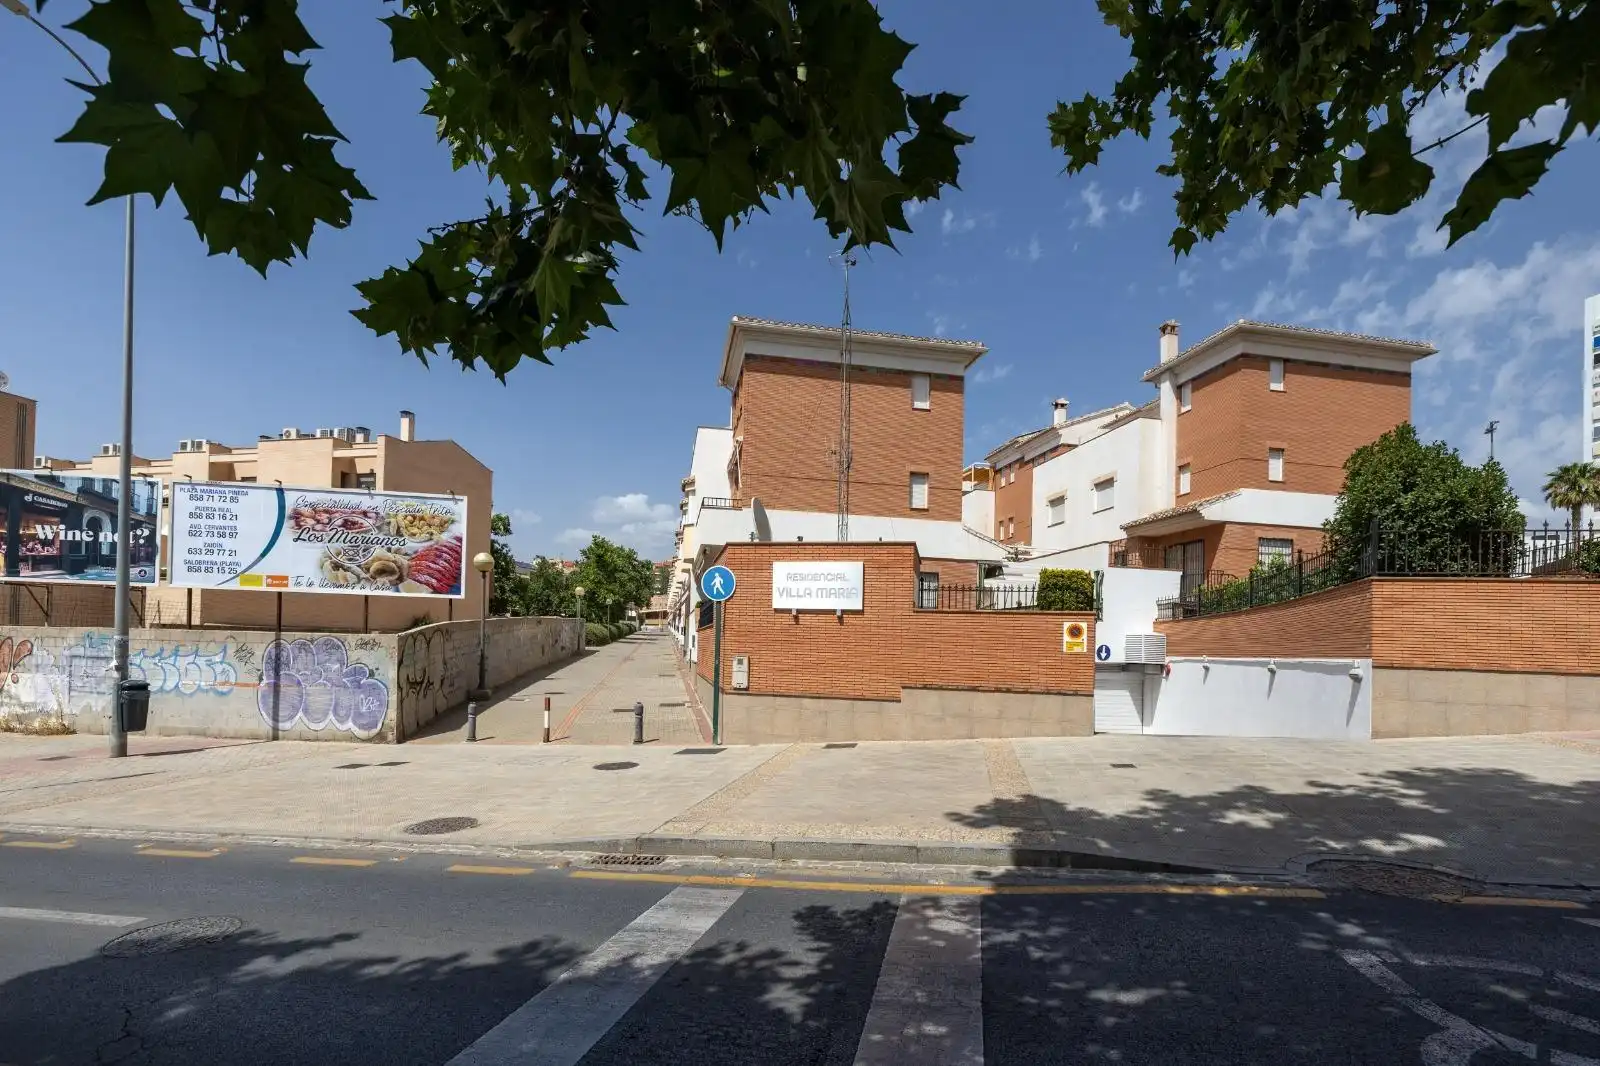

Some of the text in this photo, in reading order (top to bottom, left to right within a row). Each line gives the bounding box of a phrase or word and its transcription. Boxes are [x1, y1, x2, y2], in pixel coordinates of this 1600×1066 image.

[189, 494, 204, 502] 858
[218, 495, 228, 503] 72
[295, 495, 452, 516] Especialidad en Pescado Frito
[188, 512, 203, 520] 858
[205, 513, 215, 521] 83
[36, 524, 94, 542] Wine
[188, 530, 203, 538] 622
[216, 531, 227, 539] 58
[293, 526, 408, 547] Los Marianos
[187, 548, 203, 556] 633
[217, 549, 226, 557] 77
[187, 566, 203, 574] 858
[204, 566, 215, 574] 83
[217, 567, 226, 575] 15
[786, 572, 849, 582] RESIDENCIAL
[291, 575, 302, 587] Te
[306, 578, 316, 588] lo
[319, 577, 356, 591] llevamos
[369, 580, 393, 593] Casa
[777, 588, 813, 600] VILLA
